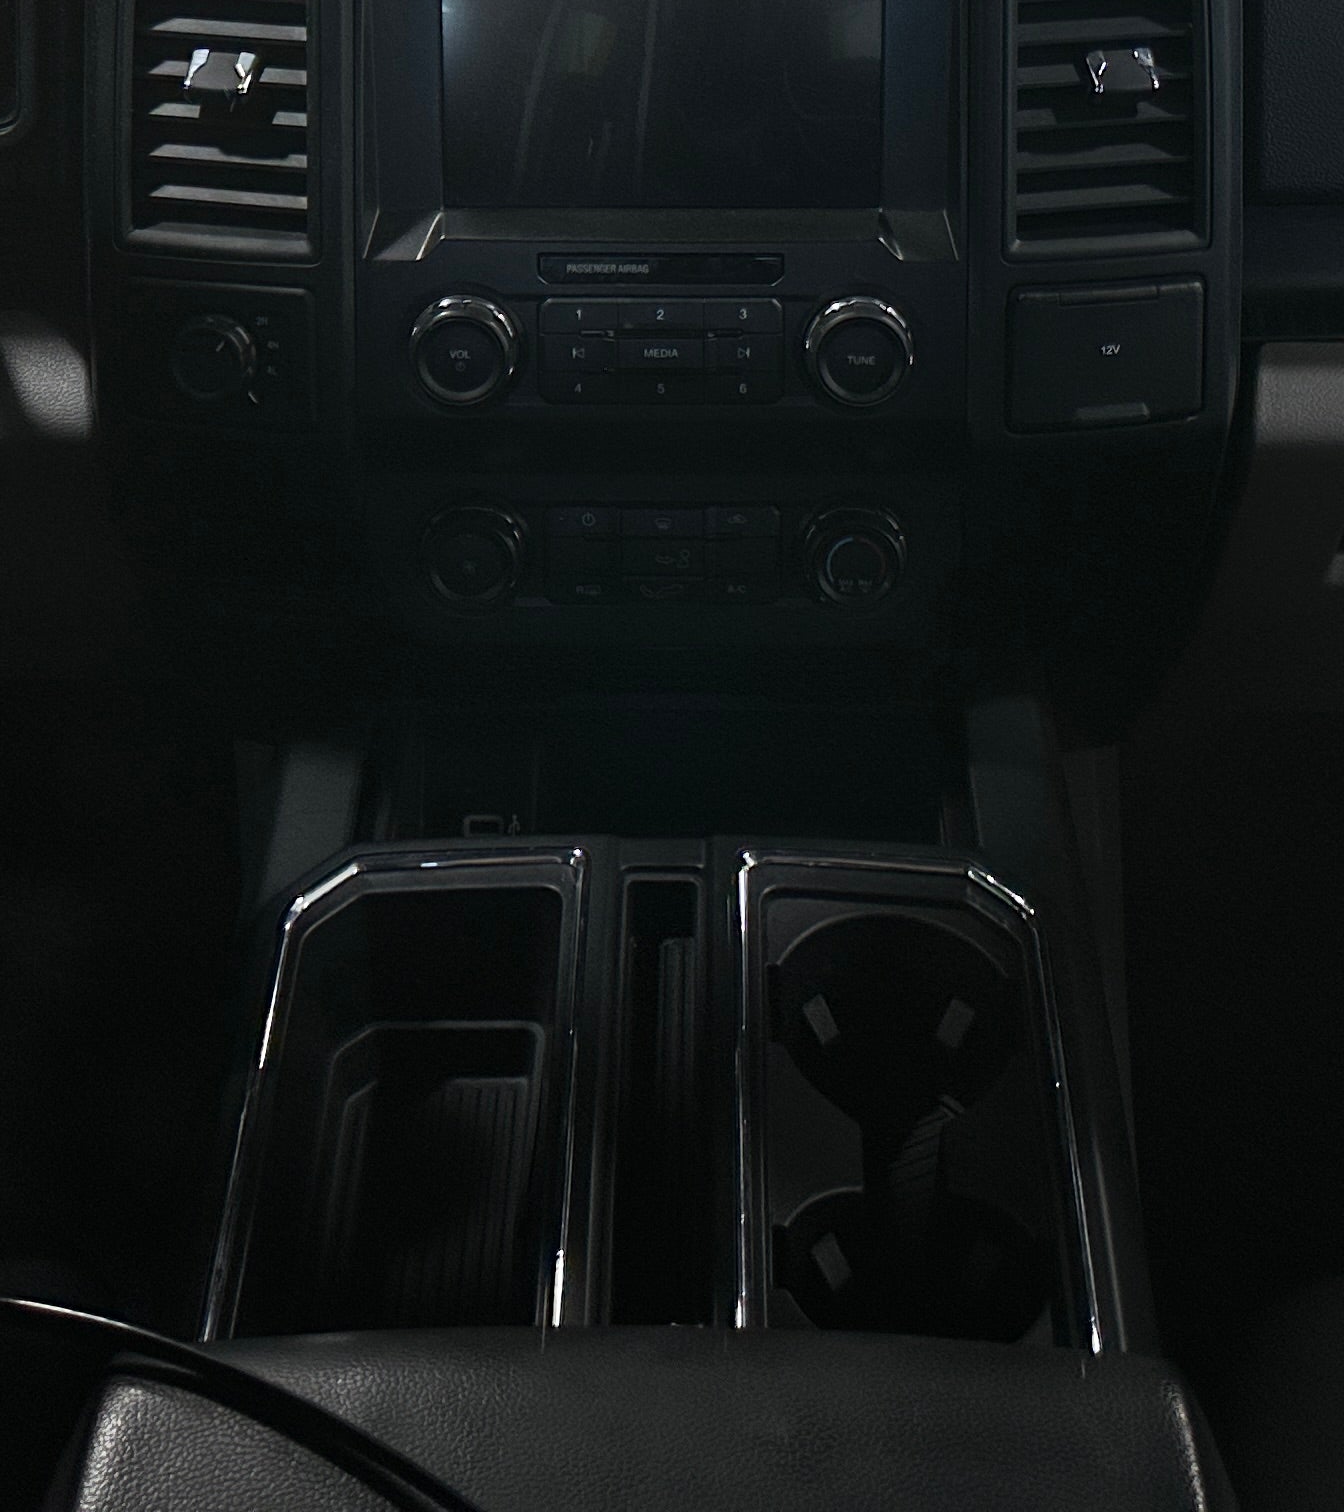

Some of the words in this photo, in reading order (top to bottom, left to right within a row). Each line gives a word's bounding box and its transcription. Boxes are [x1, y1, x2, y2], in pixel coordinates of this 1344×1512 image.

[566, 263, 616, 274] PASSENGER
[618, 263, 650, 274] AIRBAG
[575, 308, 582, 320] 1
[656, 308, 665, 320] 2
[738, 308, 747, 320] 3
[449, 349, 470, 360] VOL
[643, 347, 678, 359] MEDIA
[1099, 344, 1121, 356] 12V
[847, 355, 876, 366] TUNE
[574, 383, 582, 393] 4
[656, 383, 665, 394] 5
[739, 383, 747, 394] 6
